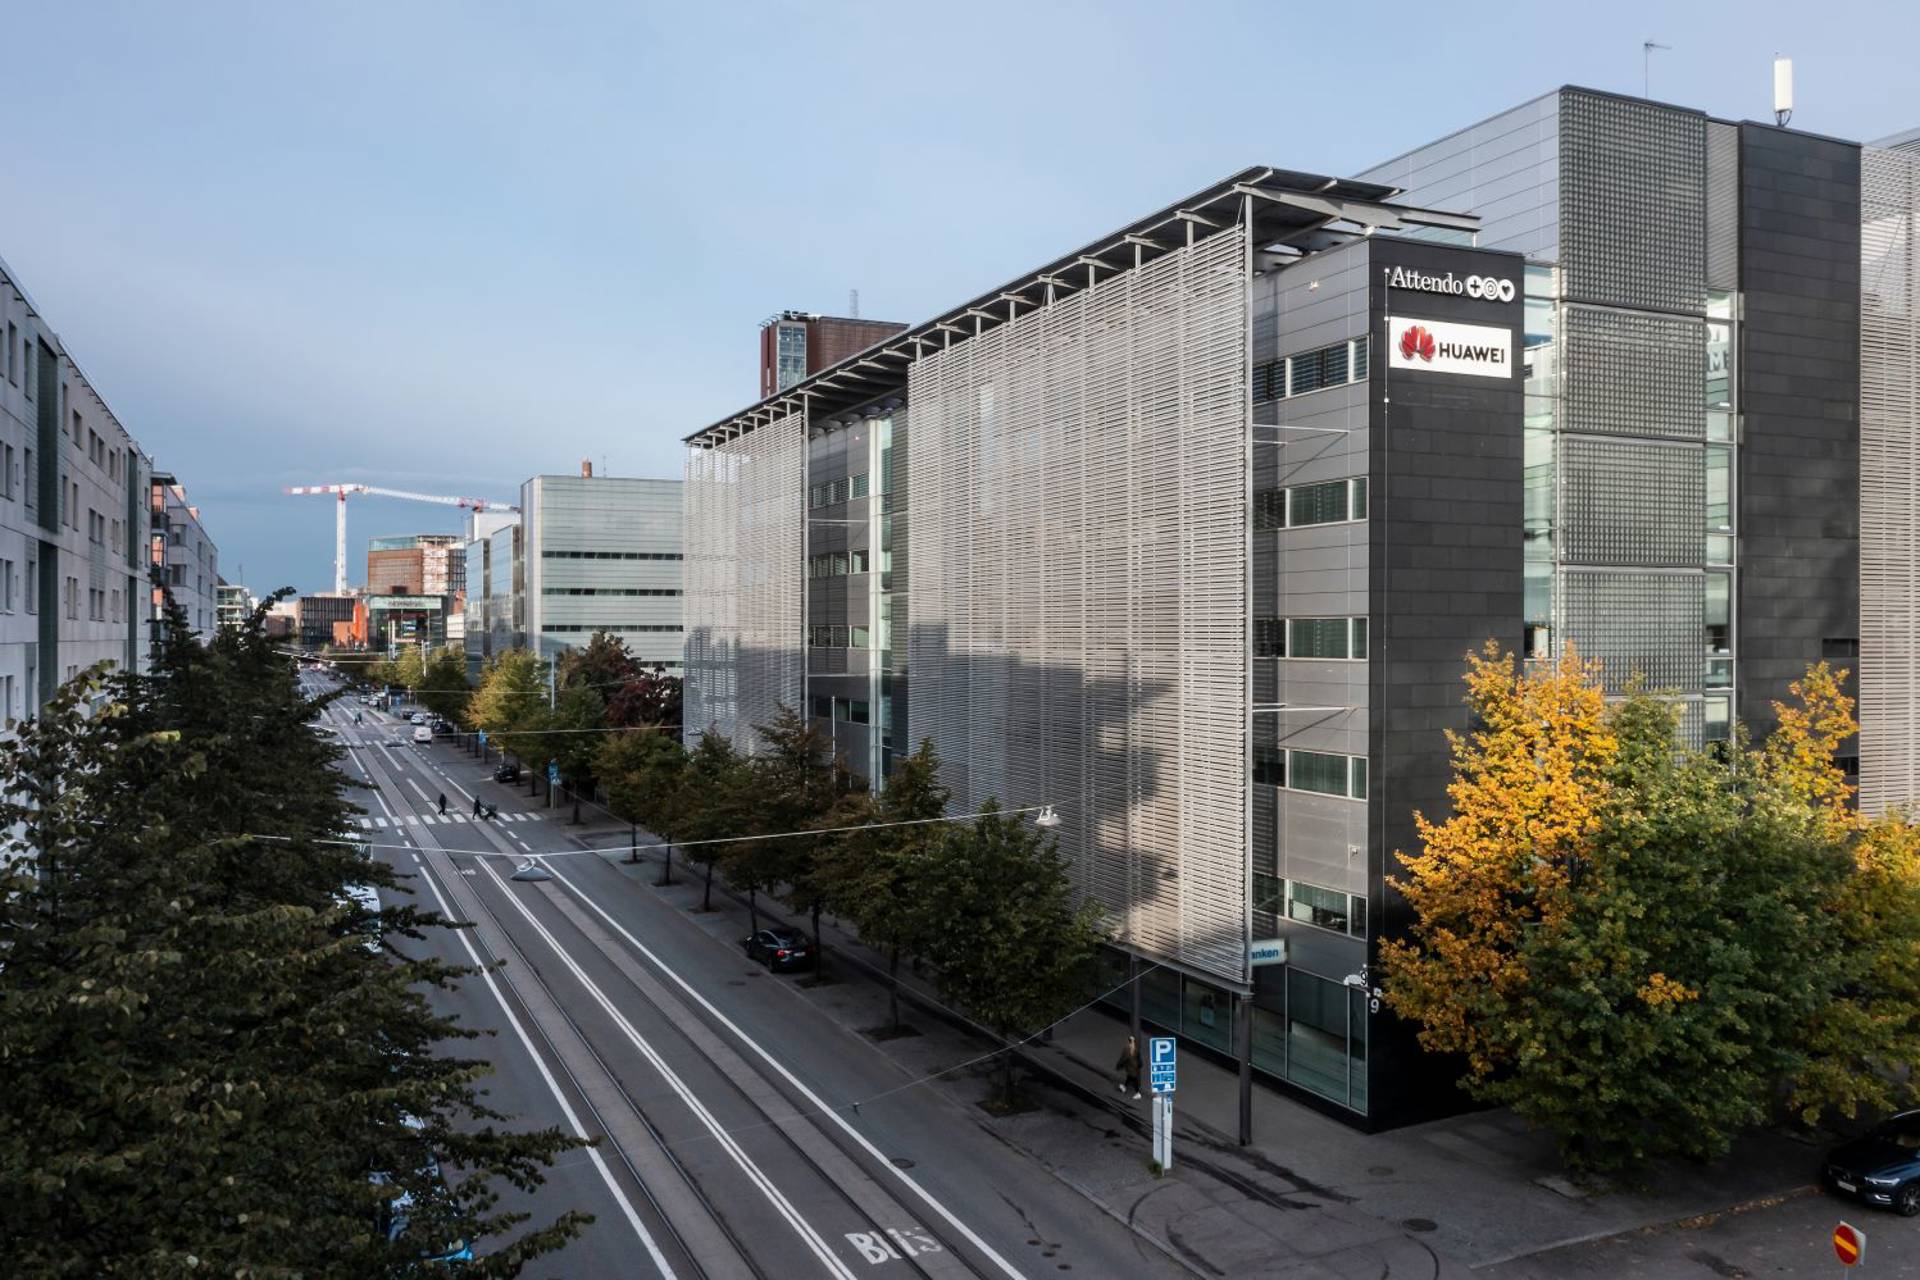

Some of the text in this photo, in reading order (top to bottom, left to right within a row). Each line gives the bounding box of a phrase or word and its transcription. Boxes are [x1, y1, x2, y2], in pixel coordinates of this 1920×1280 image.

[1390, 266, 1463, 295] Attendo
[1439, 342, 1505, 363] HUAWEI
[1361, 971, 1367, 985] 9
[1371, 999, 1379, 1014] 9
[1155, 1041, 1172, 1062] P
[844, 1227, 942, 1265] BUS
